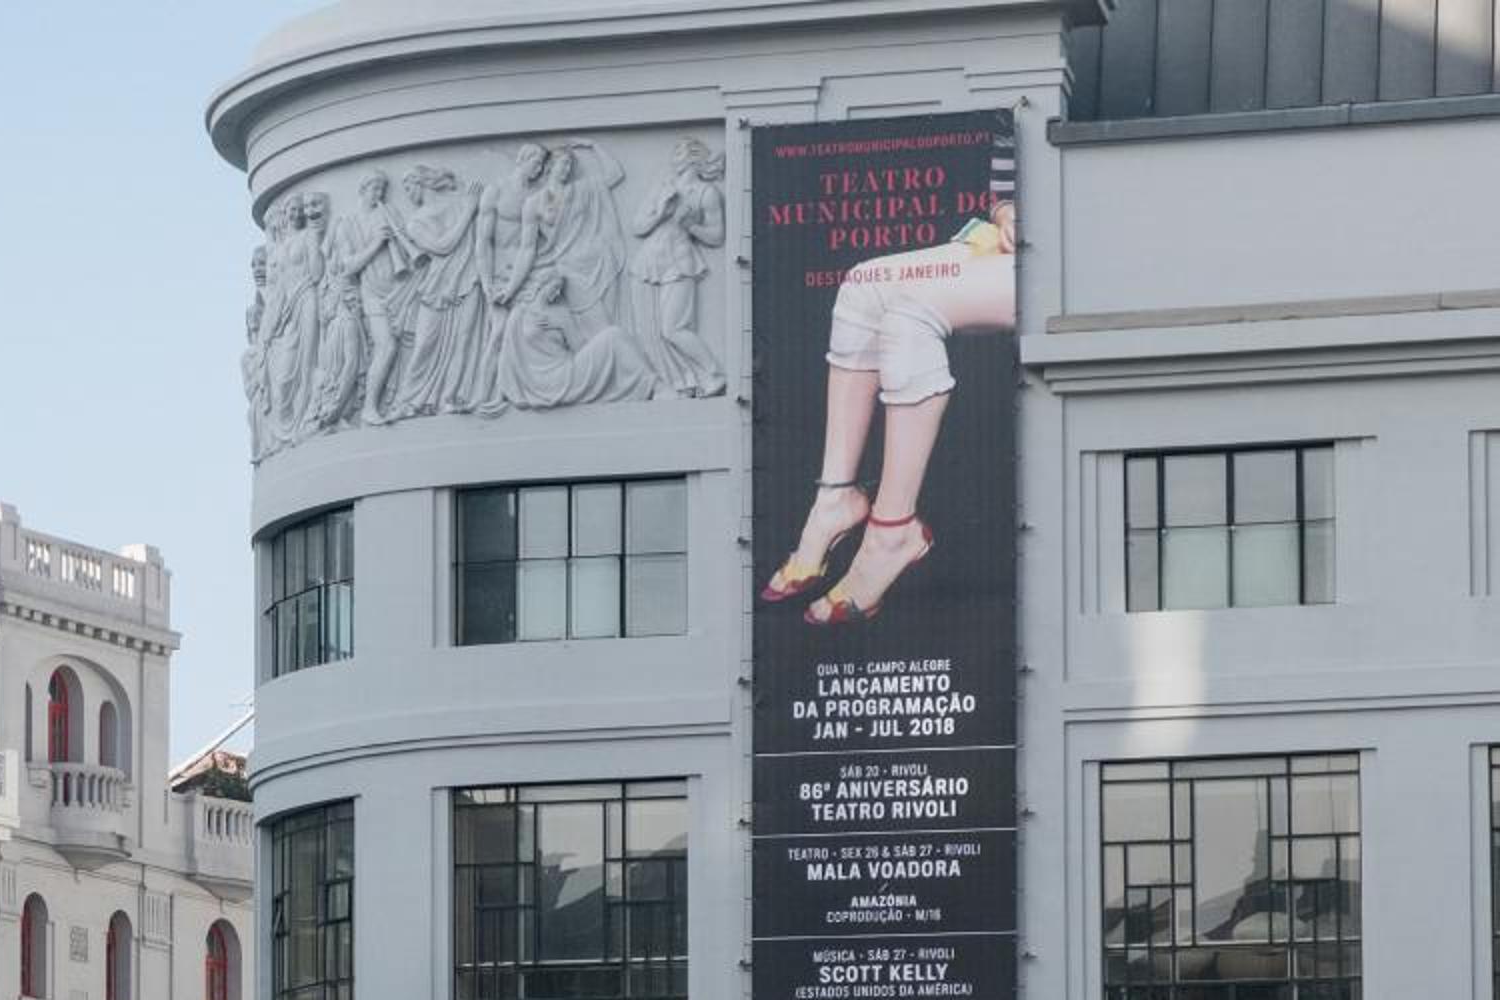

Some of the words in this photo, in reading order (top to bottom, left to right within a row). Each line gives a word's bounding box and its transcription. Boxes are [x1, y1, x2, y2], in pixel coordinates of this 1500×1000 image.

[820, 166, 945, 195] TEATRO
[768, 193, 944, 225] MUNICIPAL
[957, 191, 998, 215] DO
[829, 222, 936, 250] PORTO
[805, 266, 892, 287] DESTAQUES
[899, 263, 961, 281] JANEIRO
[817, 663, 839, 676] QUA
[867, 660, 905, 674] CAMPO
[909, 659, 952, 672] ALEGRE
[818, 674, 951, 699] LANÇAMENTO
[793, 701, 819, 718] DA
[826, 692, 976, 717] PROGRAMAÇÃO
[813, 722, 849, 739] JAN
[869, 720, 903, 737] JUL
[910, 717, 955, 735] 2018
[840, 764, 862, 778] SÁB
[891, 763, 928, 777] RIVOLI
[836, 775, 969, 799] ANIVERSÁRIO
[812, 802, 885, 821] TEATRO
[892, 800, 957, 819] RIVOLI
[788, 848, 828, 861] TEATRO
[841, 846, 862, 859] SEX
[893, 843, 916, 857] SÁB
[919, 844, 933, 856] 27
[945, 843, 981, 856] RIVOLI
[807, 863, 861, 881] MALA
[868, 860, 961, 879] VOADORA
[826, 909, 903, 924] COPRODUÇÃO
[813, 949, 855, 963] MÚSICA
[868, 947, 889, 961] SÁB
[893, 949, 906, 961] 27
[918, 948, 955, 960] RIVOLI
[819, 965, 883, 983] SCOTT
[889, 963, 948, 981] KELLY
[795, 985, 850, 999] (ESTADOS
[853, 984, 896, 997] UNIDOS
[900, 984, 915, 996] DA
[918, 981, 973, 996] AMÉRICA)
